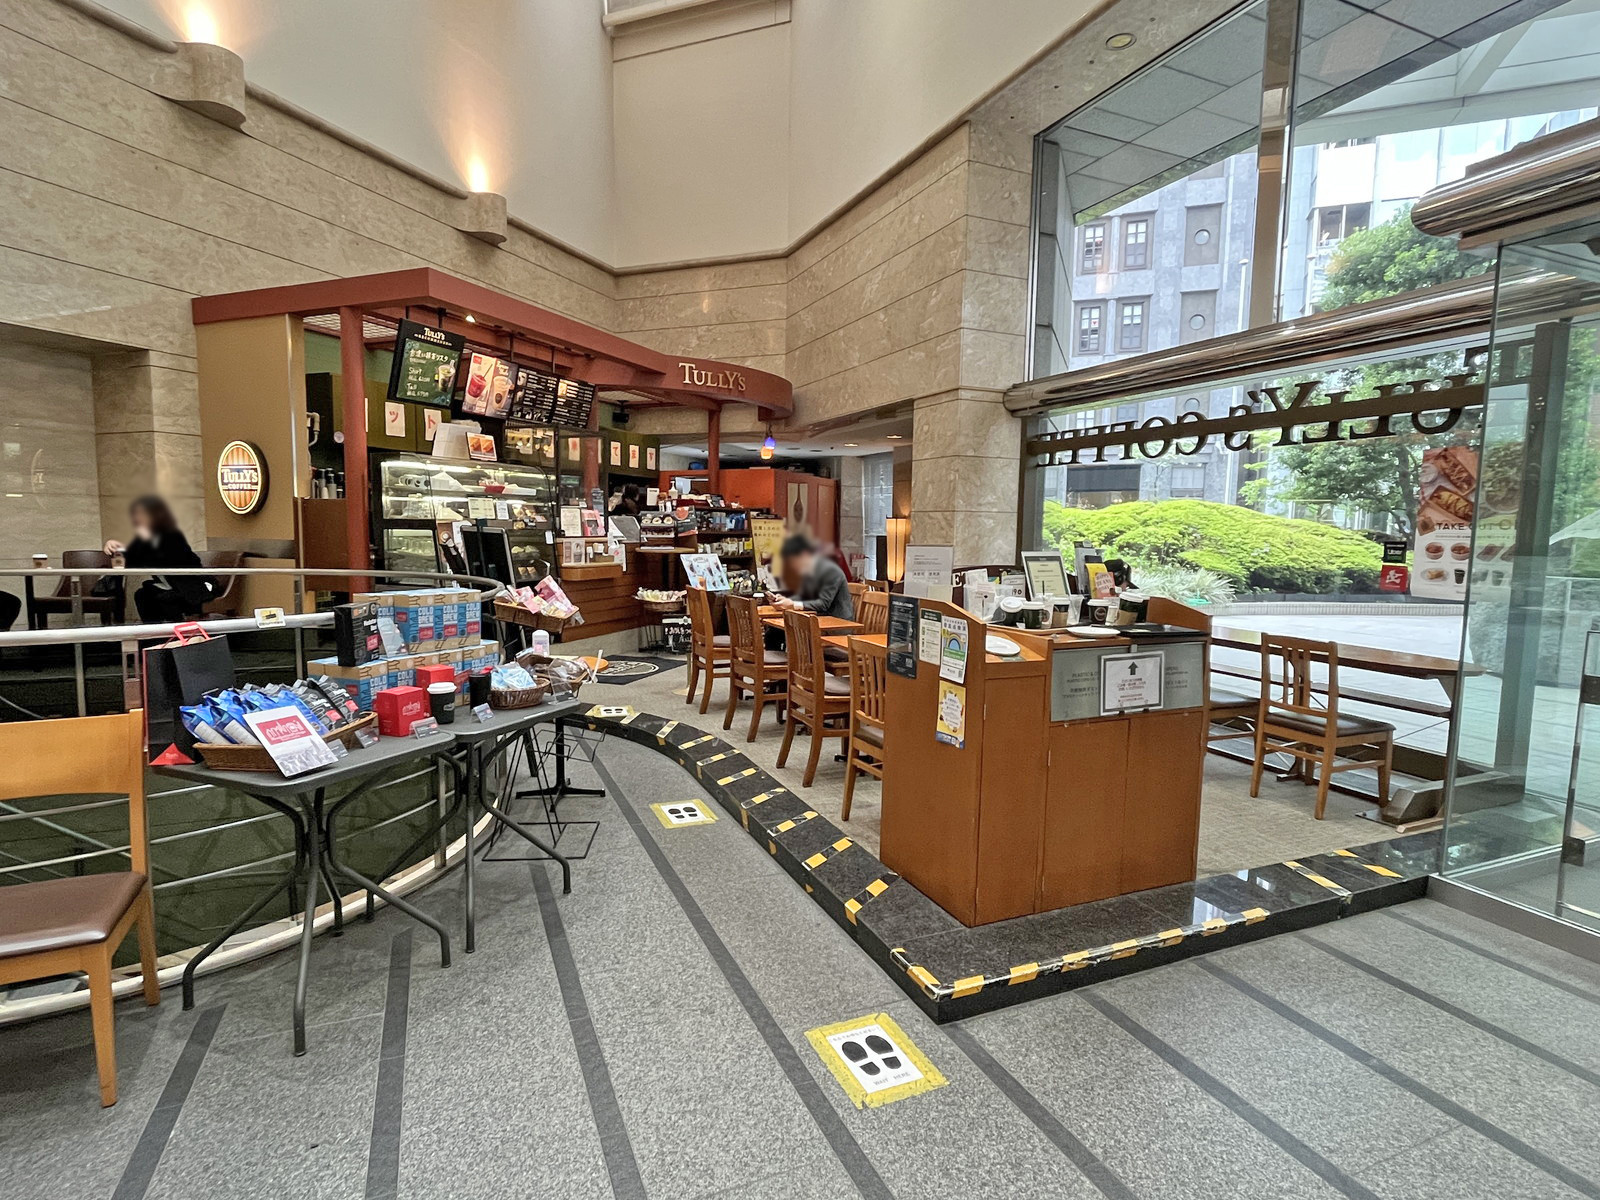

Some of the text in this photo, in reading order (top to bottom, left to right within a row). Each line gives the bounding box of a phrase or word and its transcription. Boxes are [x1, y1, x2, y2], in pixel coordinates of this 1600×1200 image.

[679, 363, 746, 391] TULLY'S
[221, 468, 258, 483] TULLY'S
[1436, 522, 1465, 531] TAKE
[418, 606, 434, 615] COLD
[442, 605, 458, 614] COLD
[466, 602, 480, 611] COLD
[398, 671, 413, 680] COLD
[370, 676, 387, 686] COLD
[893, 1071, 910, 1080] HERE
